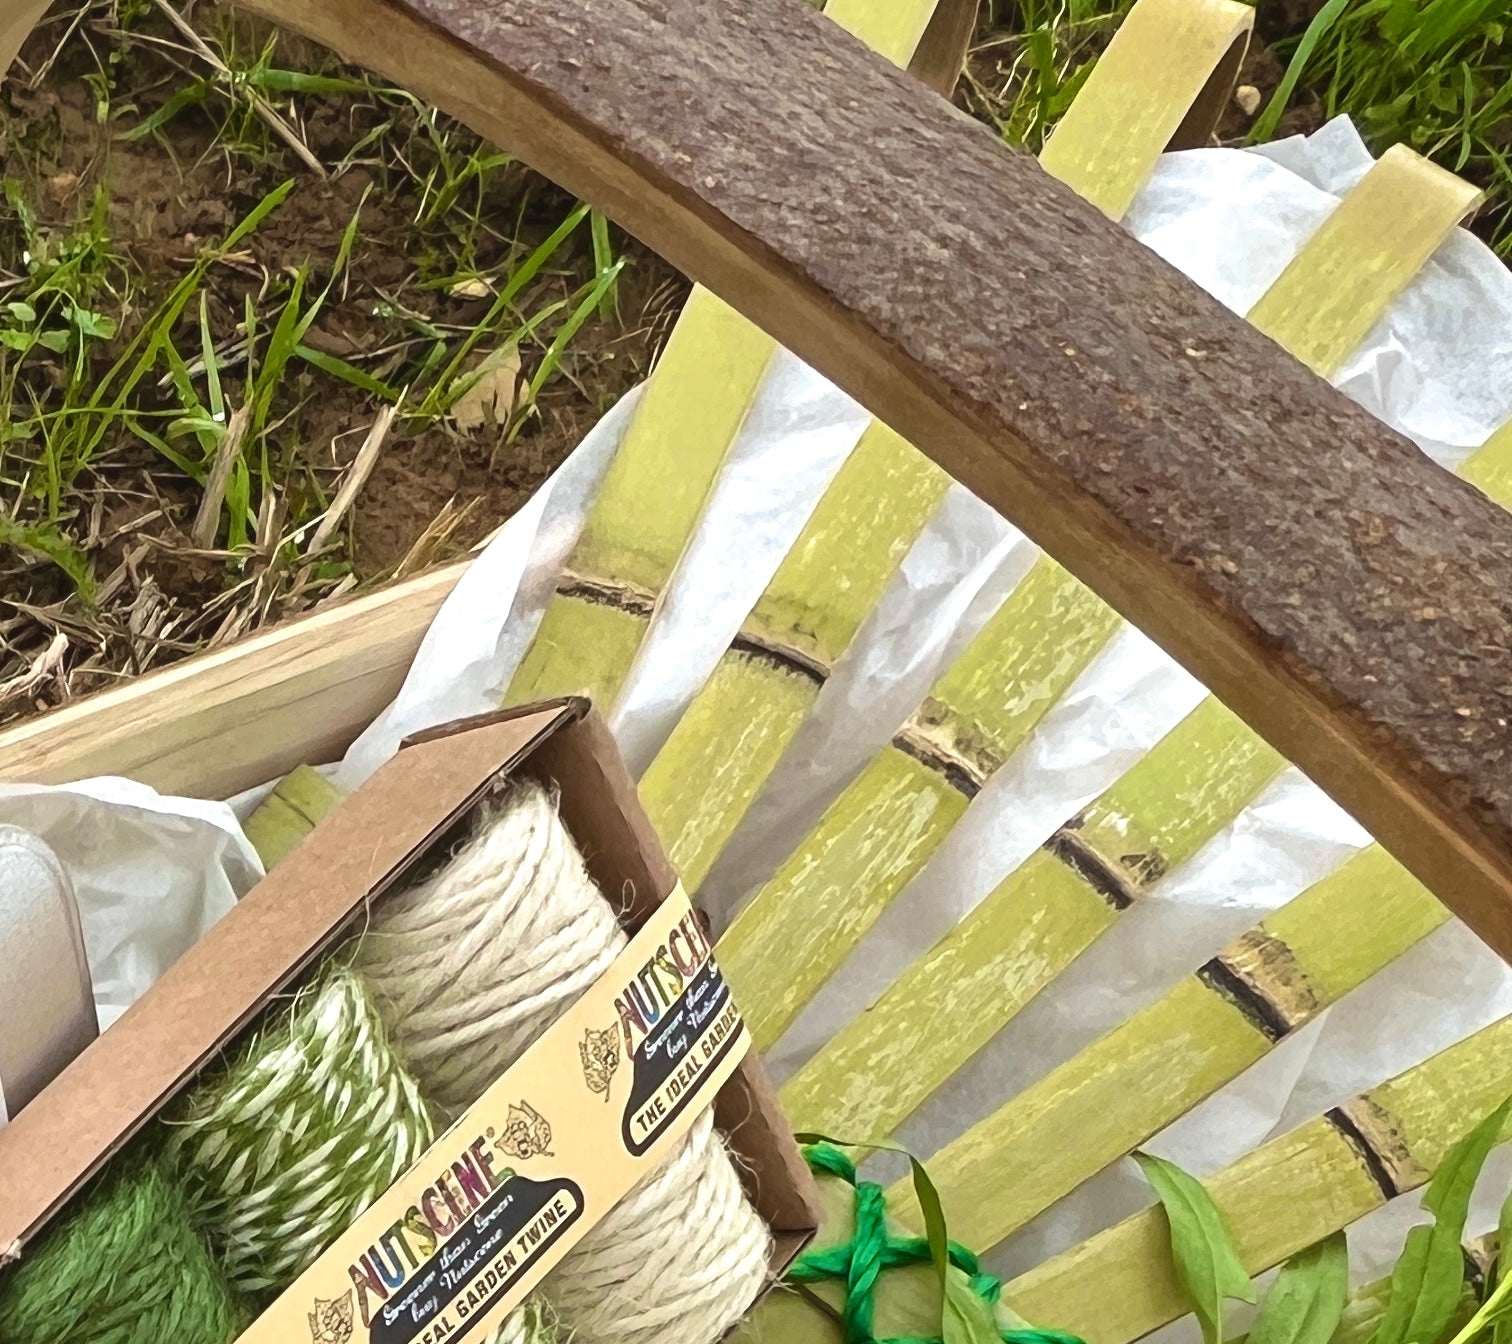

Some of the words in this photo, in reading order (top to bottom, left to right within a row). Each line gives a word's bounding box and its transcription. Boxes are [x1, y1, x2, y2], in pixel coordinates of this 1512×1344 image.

[636, 1098, 667, 1133] THE
[666, 1054, 703, 1102] IDEAL
[347, 1135, 517, 1328] NUTSCENE
[456, 1252, 518, 1319] GARDEN
[516, 1199, 569, 1255] TWINE
